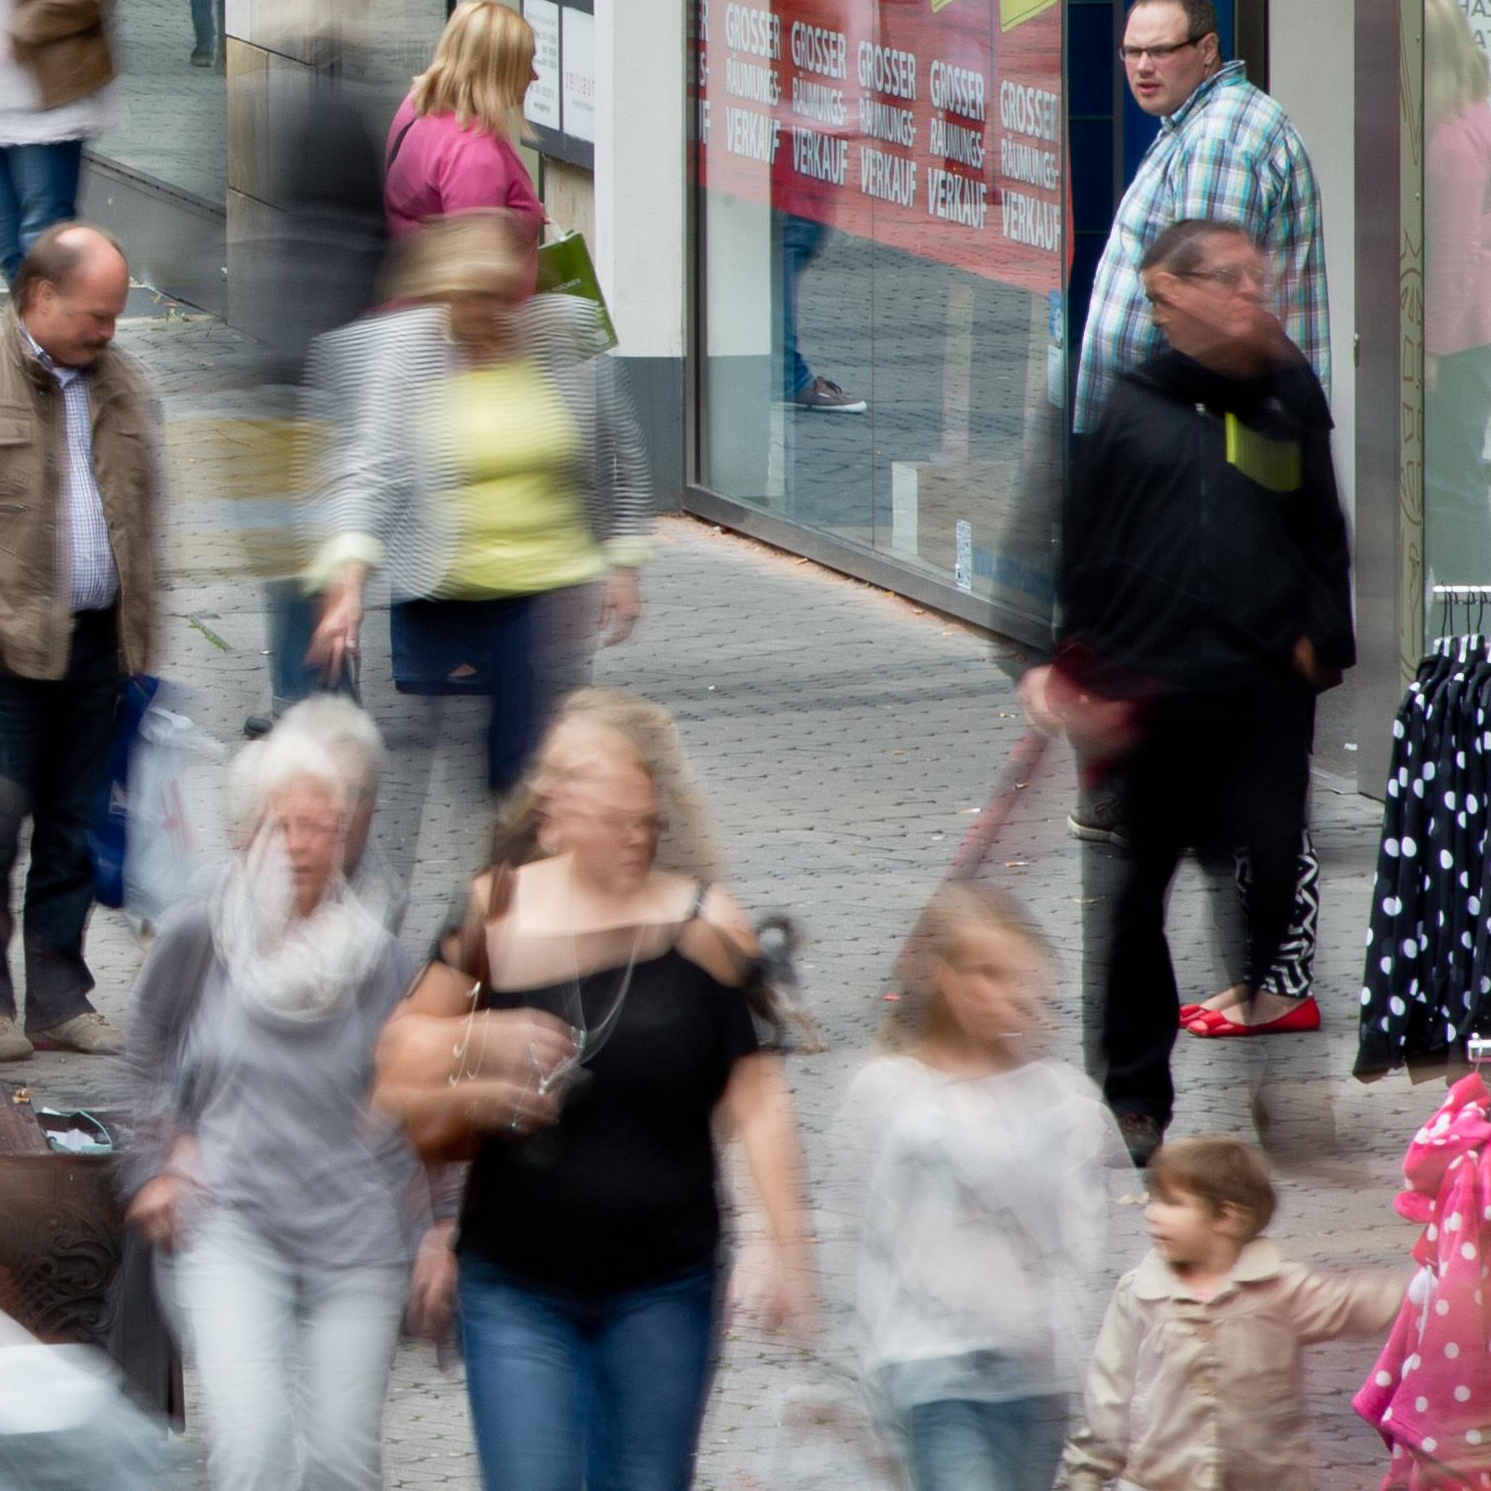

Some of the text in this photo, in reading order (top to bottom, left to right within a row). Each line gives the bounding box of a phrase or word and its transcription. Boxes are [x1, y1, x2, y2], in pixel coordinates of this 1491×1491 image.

[725, 1, 781, 60] GROSSER
[791, 20, 847, 80] GROSSER
[725, 52, 782, 107] RÄUMUNGS-
[792, 71, 848, 127] RÄUMUNGS-
[857, 40, 917, 101] GROSSER
[930, 59, 986, 122] GROSSER
[725, 105, 782, 165] VERKAUF
[858, 91, 917, 148] RÄUMUNGS-
[929, 111, 986, 169] RÄUMUNGS-
[791, 124, 849, 186] VERKAUF
[860, 145, 917, 208] VERKAUF
[1000, 133, 1060, 191] RÄUMUNGS-
[927, 166, 988, 230] VERKAUF
[1001, 188, 1062, 253] VERKAUF
